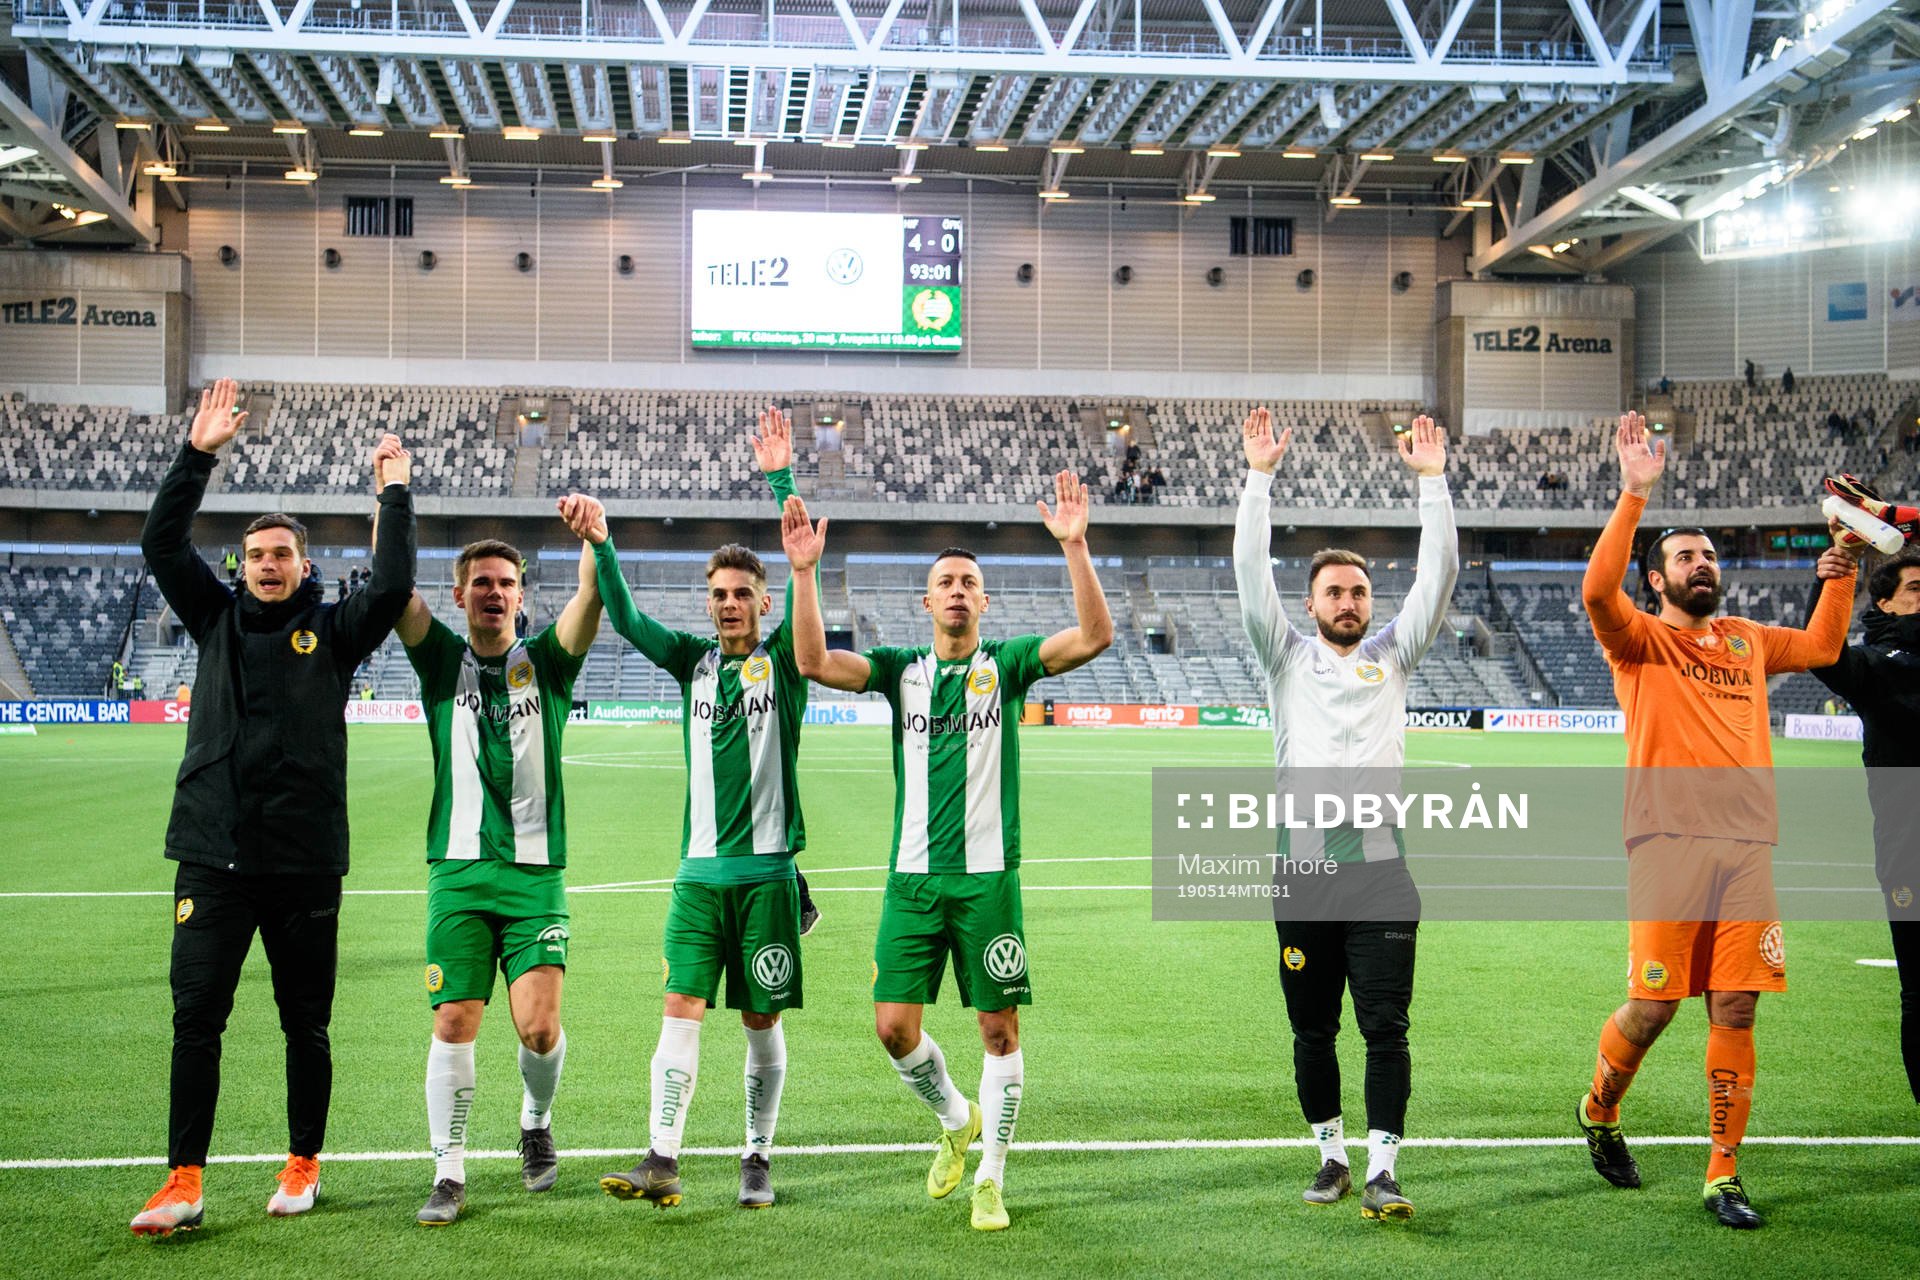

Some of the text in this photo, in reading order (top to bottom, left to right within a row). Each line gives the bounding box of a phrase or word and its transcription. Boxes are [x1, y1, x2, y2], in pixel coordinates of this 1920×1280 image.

[908, 233, 922, 252] 4
[941, 233, 955, 253] 0
[707, 256, 789, 287] TELE2
[910, 263, 951, 280] 93:01
[2, 297, 156, 327] TELE2 Arena
[1473, 326, 1612, 353] TELE2 Arena
[1681, 662, 1752, 686] JOBMA
[25, 702, 95, 722] CENTRAL
[98, 703, 129, 722] BAR
[357, 704, 402, 717] BURGER
[903, 708, 1001, 735] JOBMAN
[1067, 705, 1112, 720] renta
[1140, 706, 1184, 721] renta
[1507, 714, 1618, 729] INTERSPORT
[660, 1068, 692, 1128] Clinton
[1710, 1068, 1739, 1135] Clinton
[449, 1087, 475, 1147] Clinton
[997, 1082, 1022, 1146] Clinton
